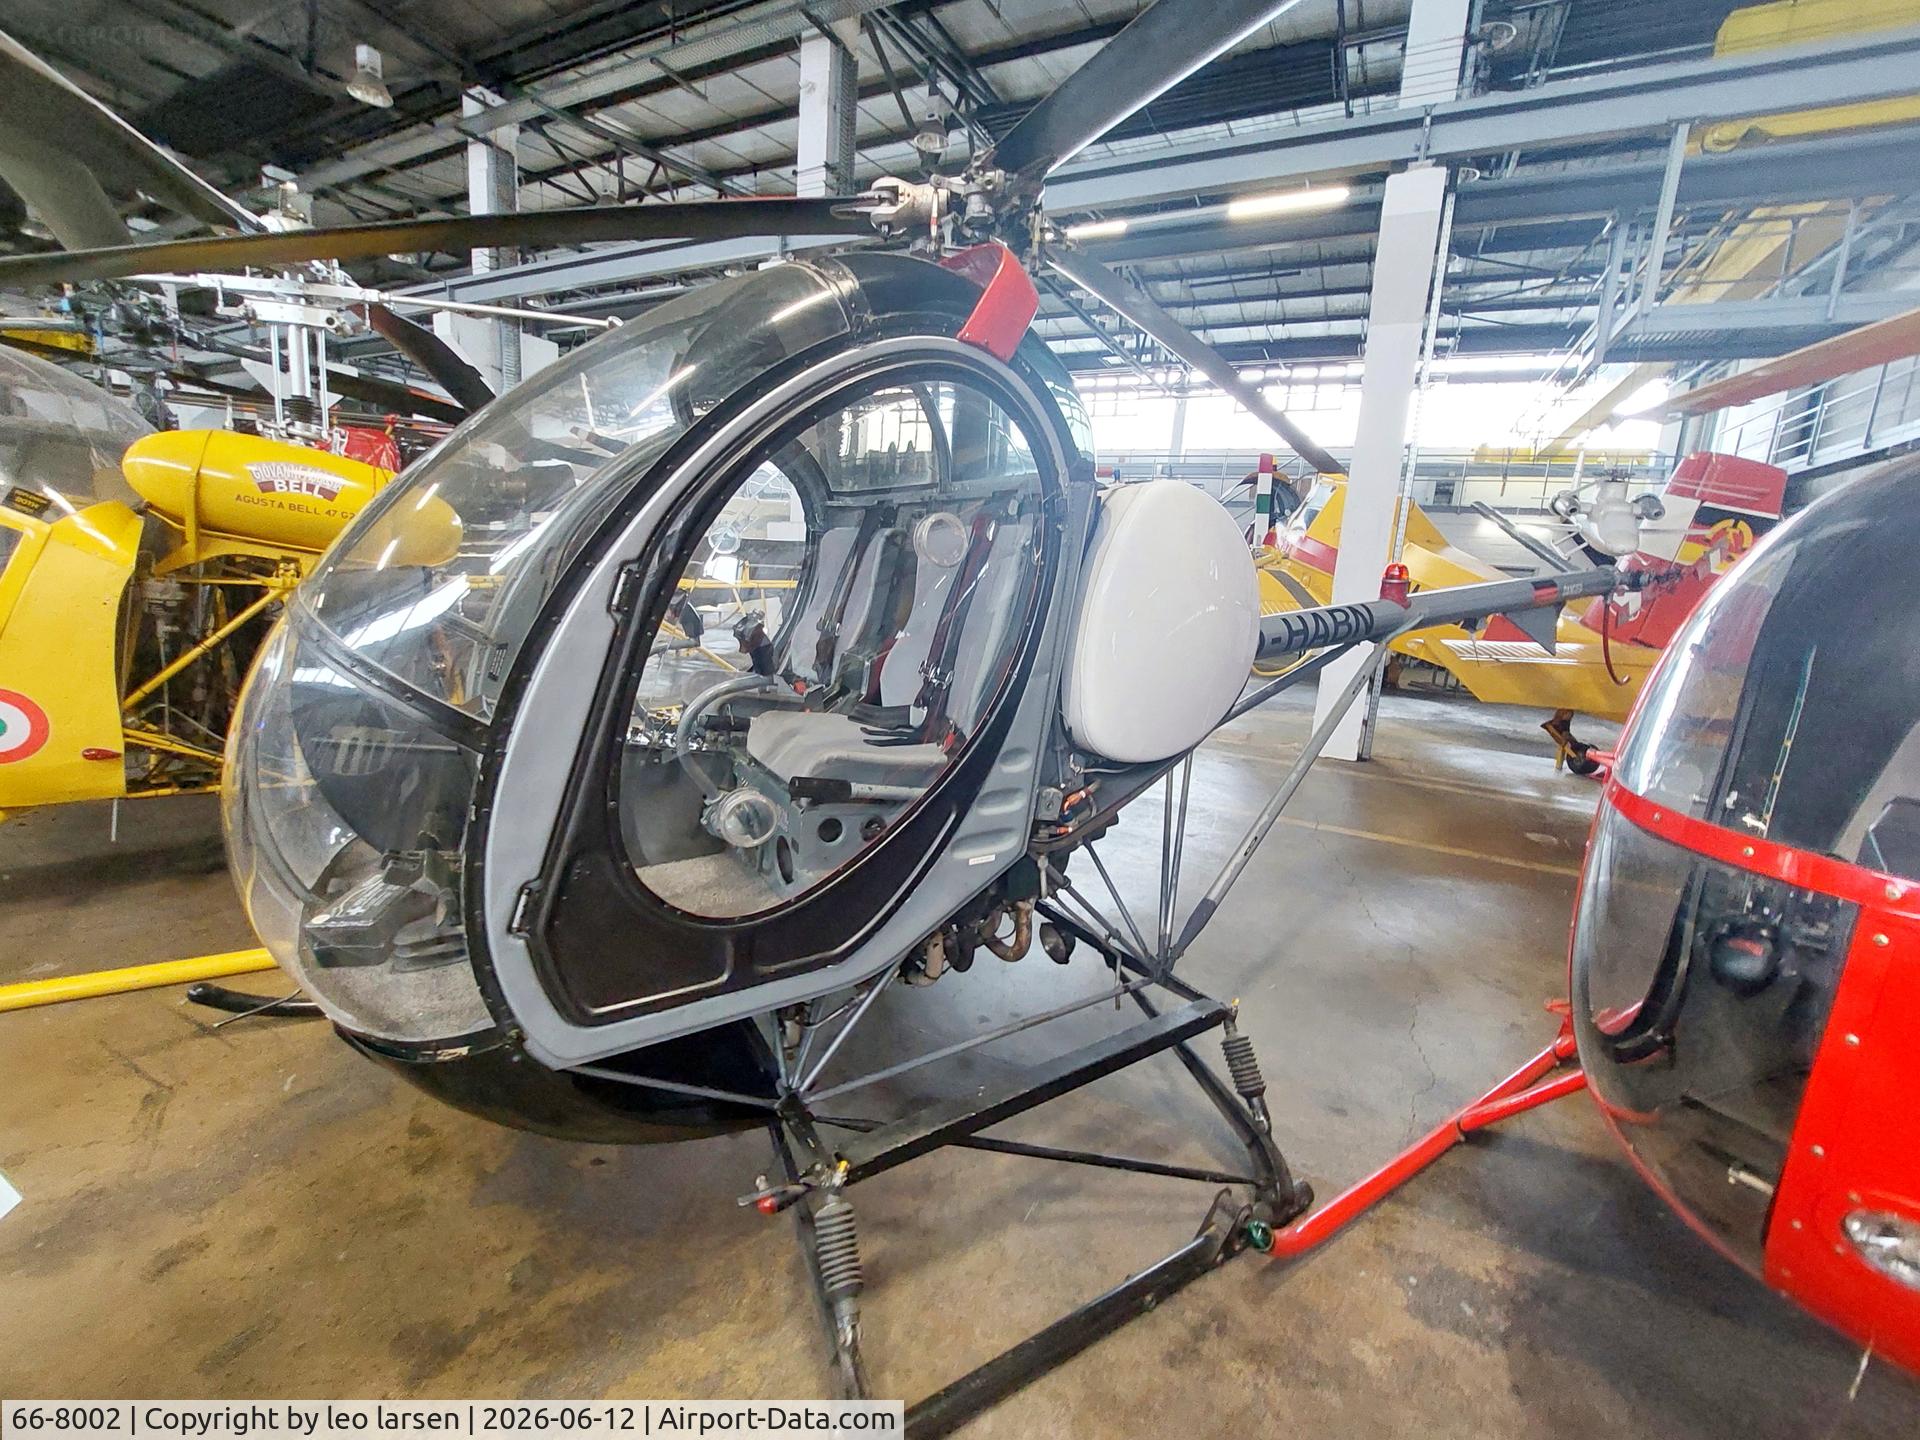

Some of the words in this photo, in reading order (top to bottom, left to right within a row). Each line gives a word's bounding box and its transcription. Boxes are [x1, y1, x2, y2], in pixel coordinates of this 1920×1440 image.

[273, 480, 324, 498] BELL
[235, 494, 285, 509] AGUSTA
[288, 503, 320, 515] BELL
[325, 509, 338, 517] 47
